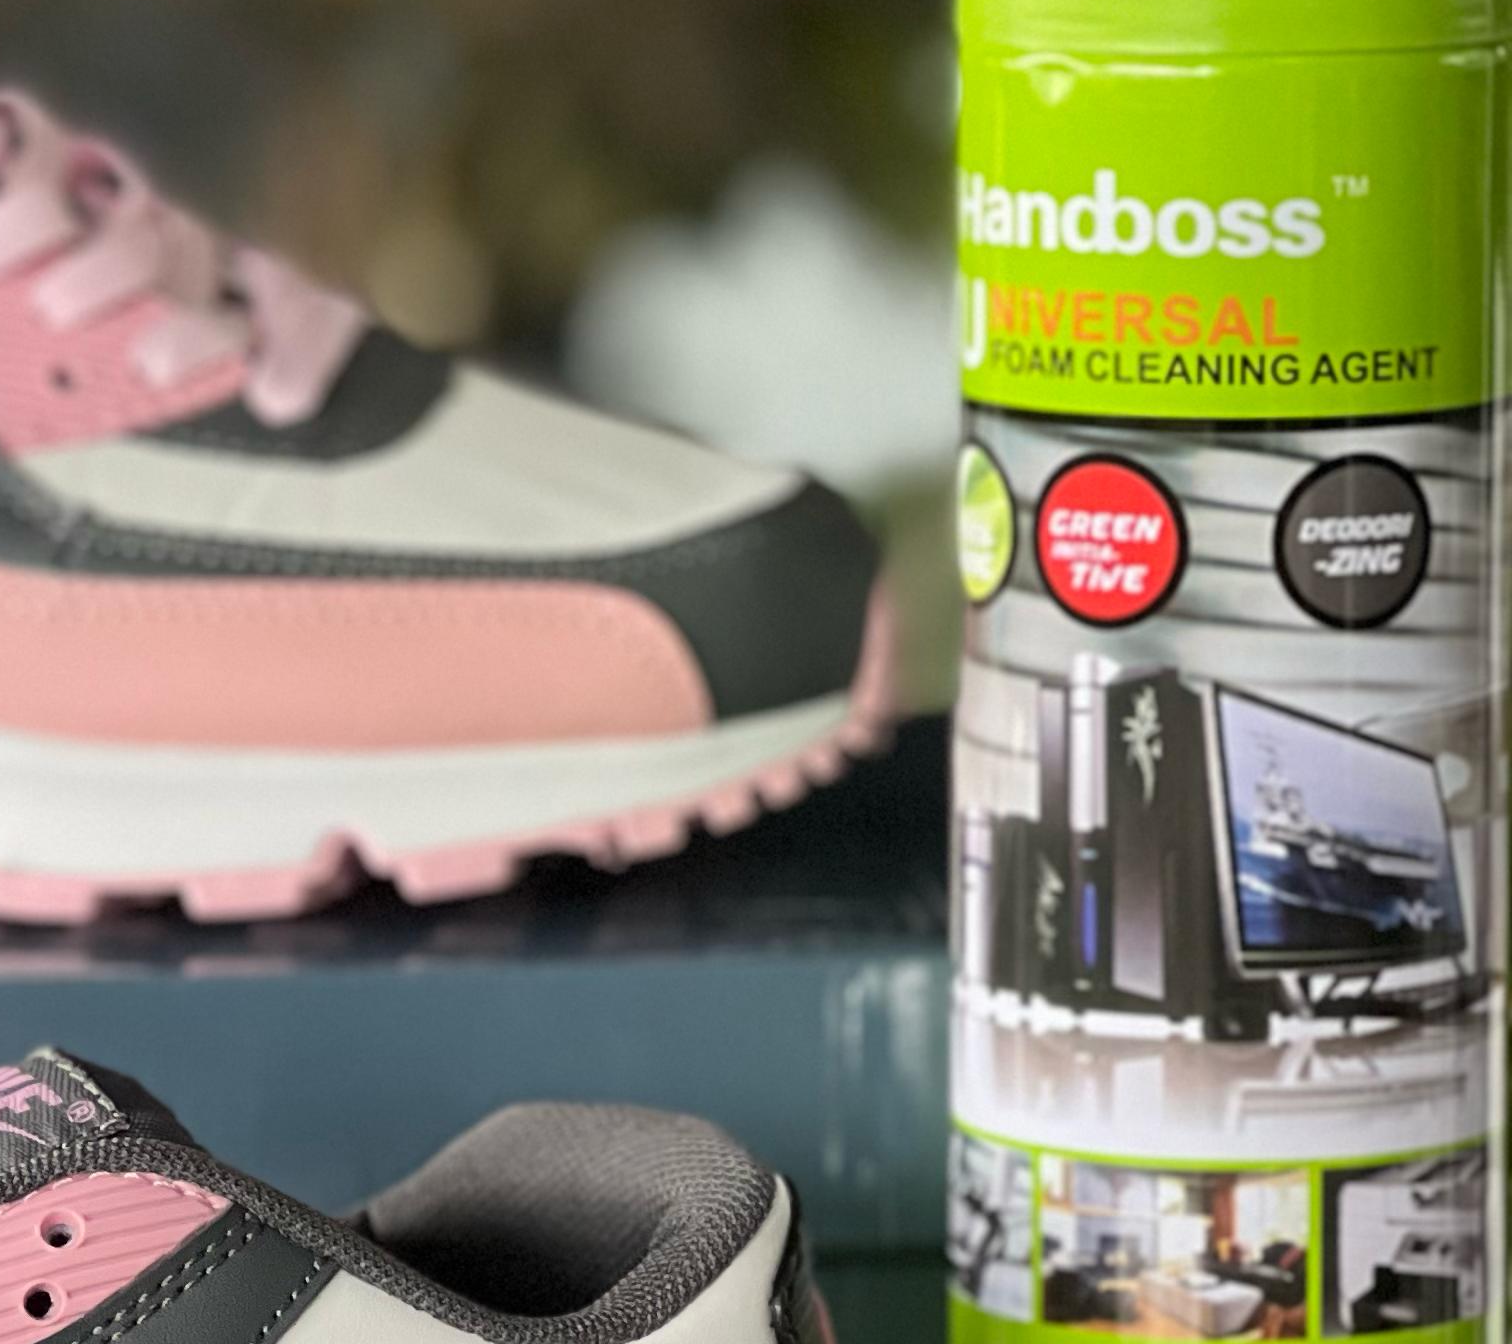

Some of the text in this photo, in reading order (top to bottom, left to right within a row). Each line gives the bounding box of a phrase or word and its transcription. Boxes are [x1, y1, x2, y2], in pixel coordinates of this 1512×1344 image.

[991, 338, 1440, 385] FOAM CLEANING AGENT
[1049, 508, 1163, 544] GREEN
[1069, 562, 1150, 594] TIVE
